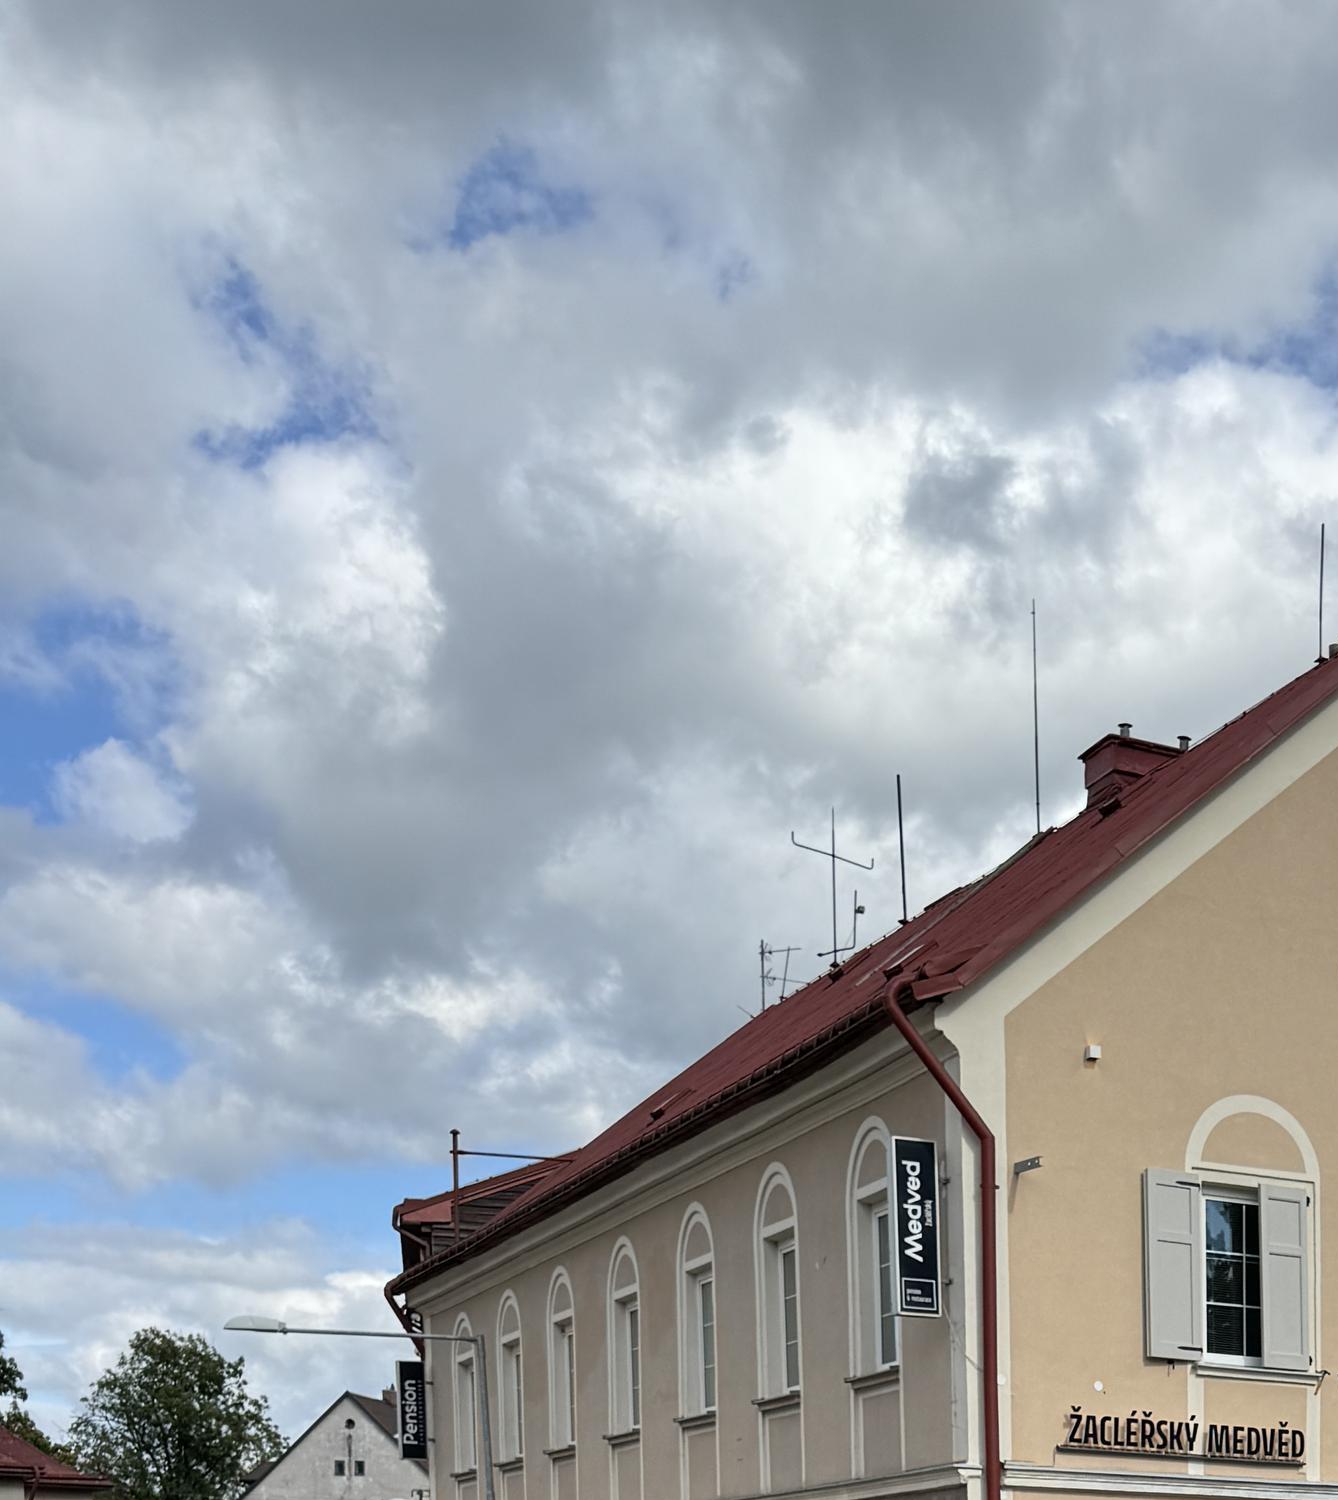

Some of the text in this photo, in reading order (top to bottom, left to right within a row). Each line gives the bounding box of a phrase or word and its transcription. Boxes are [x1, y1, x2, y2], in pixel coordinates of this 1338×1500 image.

[402, 1379, 418, 1445] Pension
[1068, 1406, 1305, 1458] ŽACLÉŘSKÝ MEDVĚD
